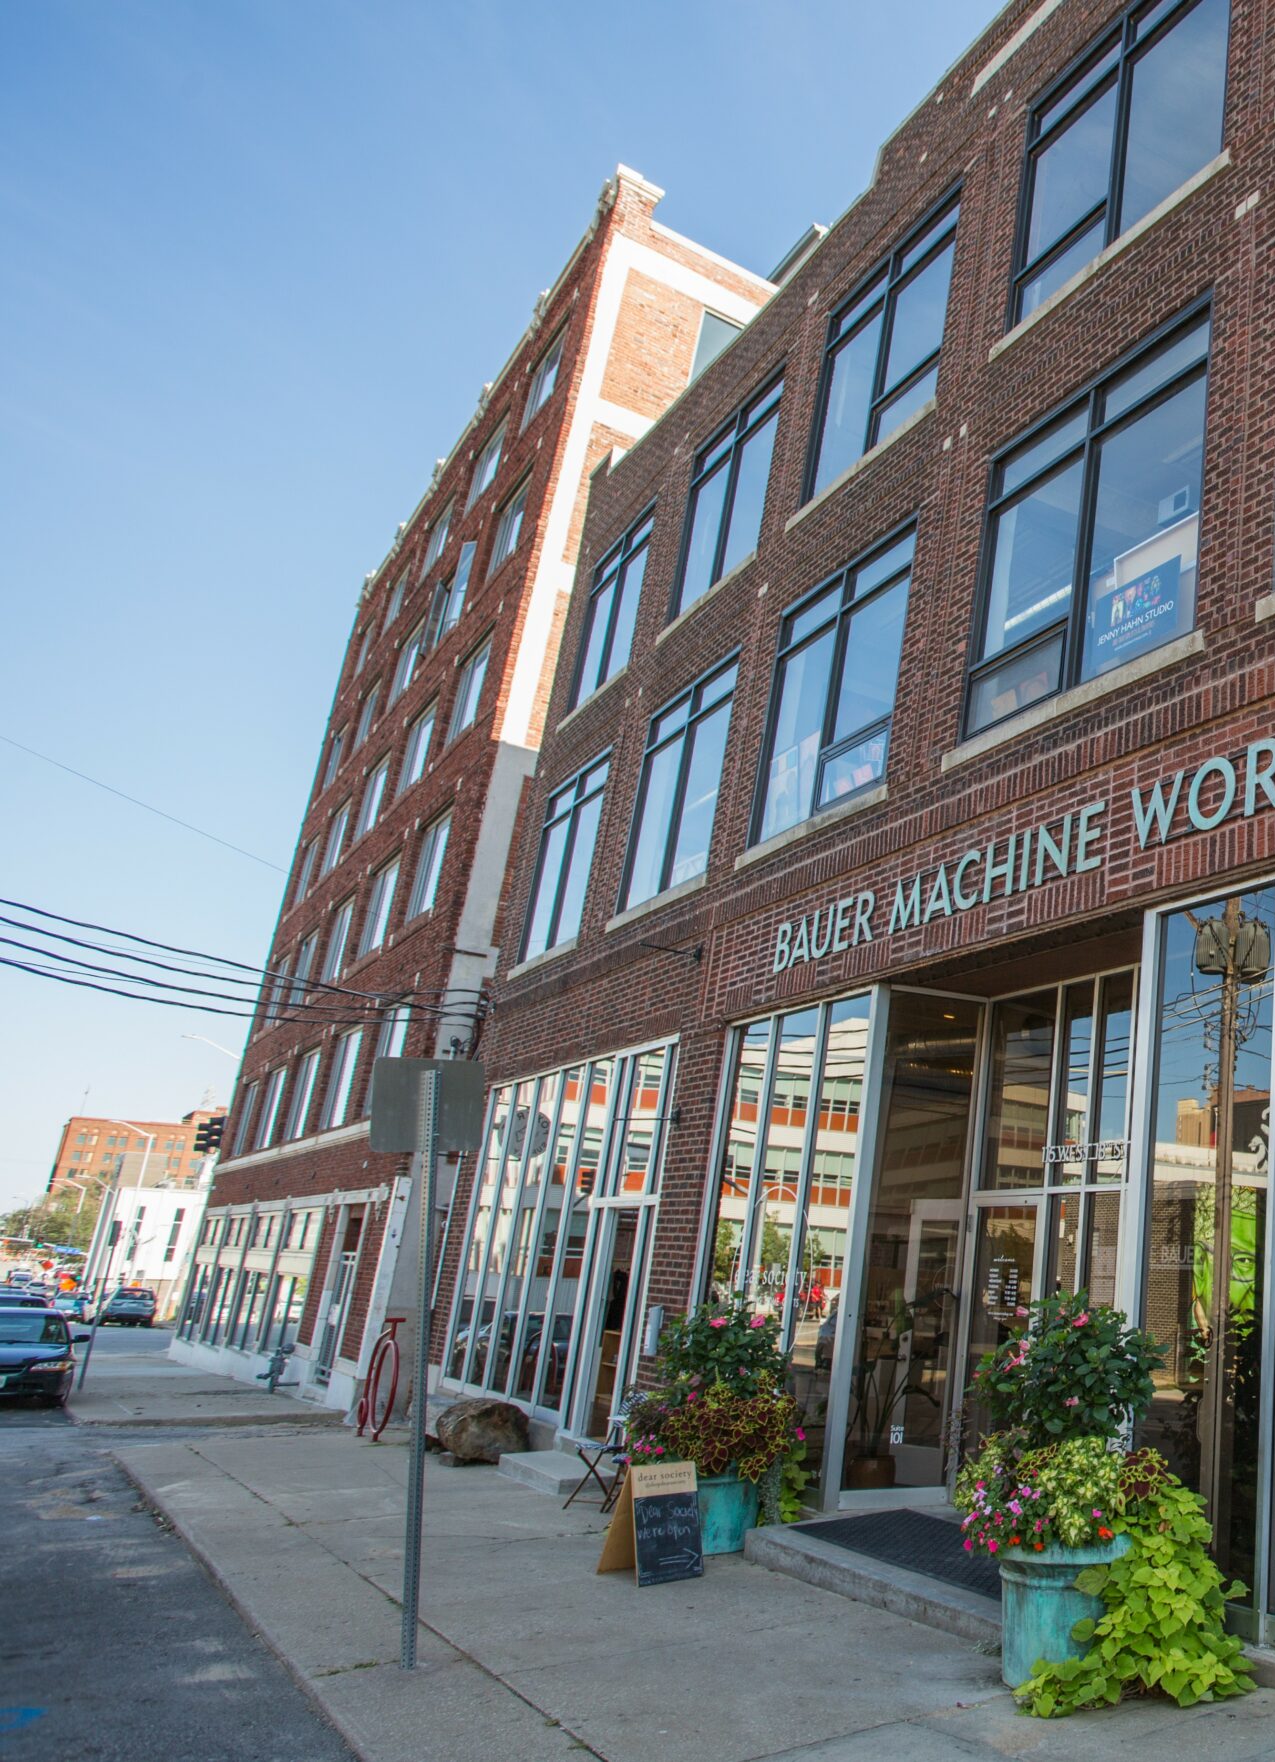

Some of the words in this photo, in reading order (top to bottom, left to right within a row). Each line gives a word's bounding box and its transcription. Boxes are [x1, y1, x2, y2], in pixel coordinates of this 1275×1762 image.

[1097, 627, 1120, 647] JENNY
[1120, 615, 1144, 633] HAHN
[1145, 600, 1174, 621] STUDIO
[772, 891, 876, 973] BAUER
[888, 801, 1106, 934] MACHINE
[638, 1472, 657, 1482] dear
[660, 1470, 692, 1481] society
